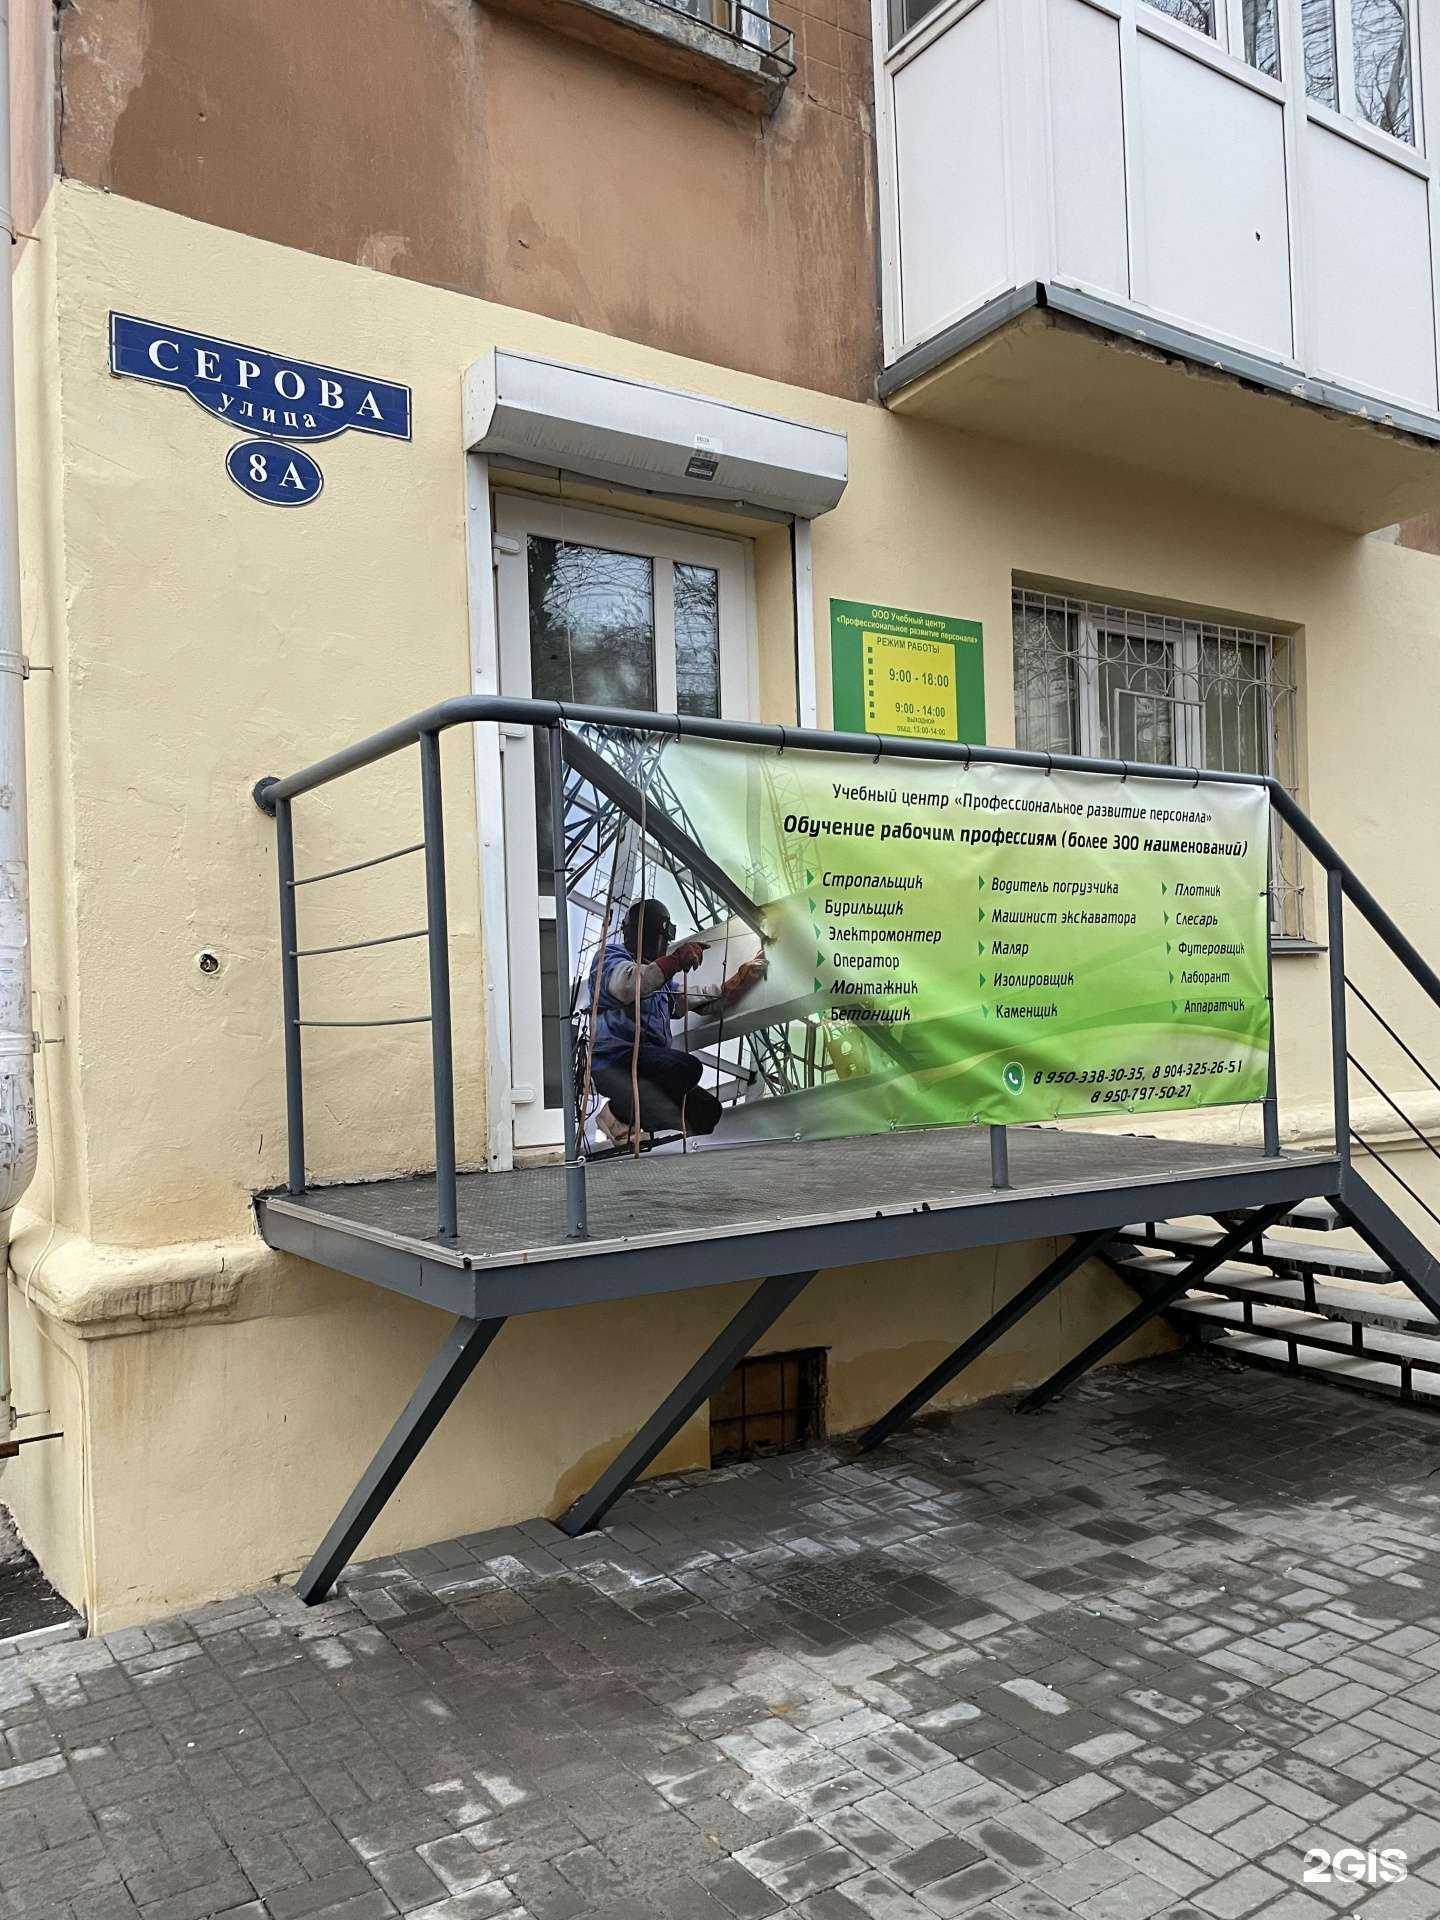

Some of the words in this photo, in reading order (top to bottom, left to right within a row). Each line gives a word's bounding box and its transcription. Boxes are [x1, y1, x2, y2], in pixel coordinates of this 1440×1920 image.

[148, 340, 384, 421] СЕРОВА
[218, 392, 317, 430] улица
[249, 453, 267, 482] 8
[279, 461, 307, 491] А
[871, 608, 890, 620] ООО
[891, 610, 924, 625] Учебный
[925, 618, 946, 630] центр
[909, 627, 940, 639] развитие
[876, 636, 906, 649] РЕЖИМ
[907, 641, 942, 654] РАБОТЫ:
[889, 668, 912, 683] 9:00
[921, 672, 949, 688] 18:00
[895, 702, 914, 714] 9:00
[923, 705, 946, 718] 14:00
[832, 783, 897, 803] Учебный
[901, 790, 949, 809] центр
[954, 793, 1084, 816] «Профессиональное
[1086, 803, 1147, 820] развитие
[1149, 807, 1212, 823] персонала»
[783, 814, 875, 838] Обучение
[880, 822, 956, 842] рабочим
[960, 826, 1057, 847] профессиям
[1061, 830, 1108, 849] (более
[1112, 834, 1140, 851] 300
[1143, 837, 1249, 857] наименований)
[822, 871, 924, 891] Стропальщик
[991, 877, 1049, 894] Водитель
[1052, 880, 1119, 896] погрузчика
[1174, 883, 1221, 897] Плотник
[824, 899, 904, 918] Бурильщик
[991, 908, 1058, 924] Машинист
[1061, 910, 1137, 926] экскаватора
[1176, 912, 1219, 928] Слесарь
[828, 926, 942, 945] Электромонтер
[991, 940, 1029, 957] Маляр
[1178, 941, 1245, 957] Футеровщик
[833, 952, 900, 971] Оператор
[829, 979, 919, 995] Монтажник
[993, 971, 1075, 989] Изолировщик
[1180, 970, 1231, 986] Лаборант
[830, 1006, 911, 1023] Бетонщик
[995, 1003, 1058, 1020] Каменщик
[1184, 998, 1245, 1014] Аппаратчик
[1033, 1071, 1043, 1085] 8
[1045, 1066, 1146, 1084] 950-338-30-35,
[1152, 1065, 1161, 1079] 8
[1163, 1060, 1242, 1078] 904-325-26-51
[1090, 1090, 1102, 1103] 8
[1102, 1084, 1192, 1103] 950-797-50-27
